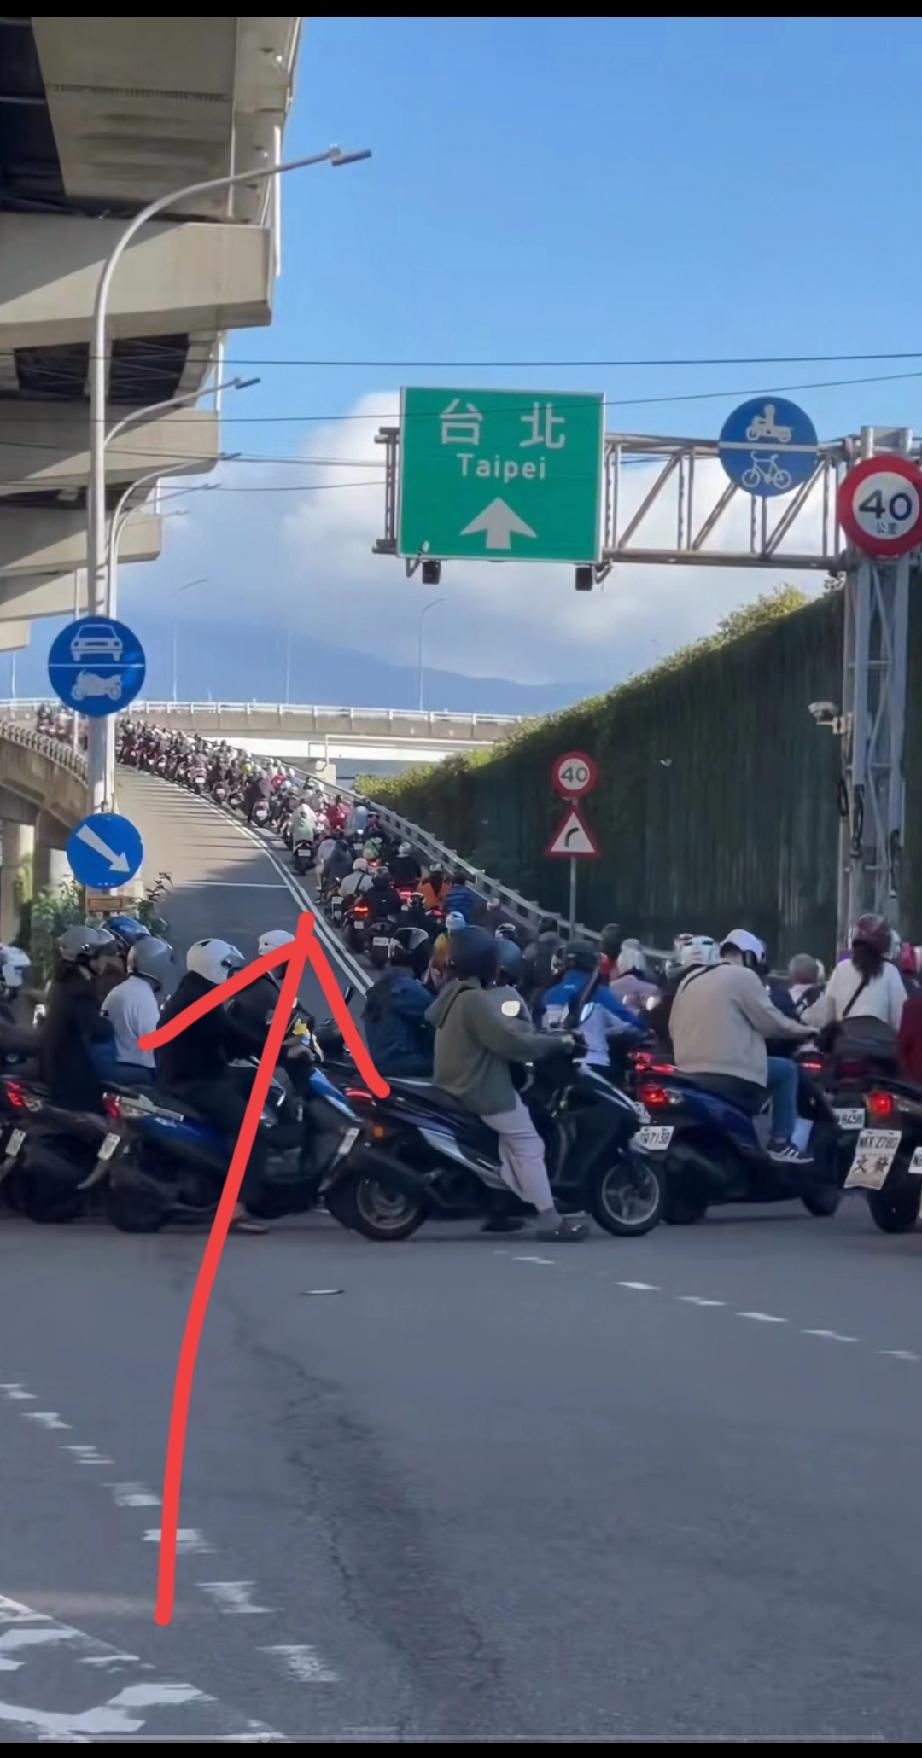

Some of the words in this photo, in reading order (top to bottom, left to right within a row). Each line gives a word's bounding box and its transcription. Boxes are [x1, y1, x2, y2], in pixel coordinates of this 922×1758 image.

[439, 398, 566, 448] 台北
[456, 453, 547, 484] Taipei
[858, 489, 914, 522] 40
[560, 765, 589, 783] 40
